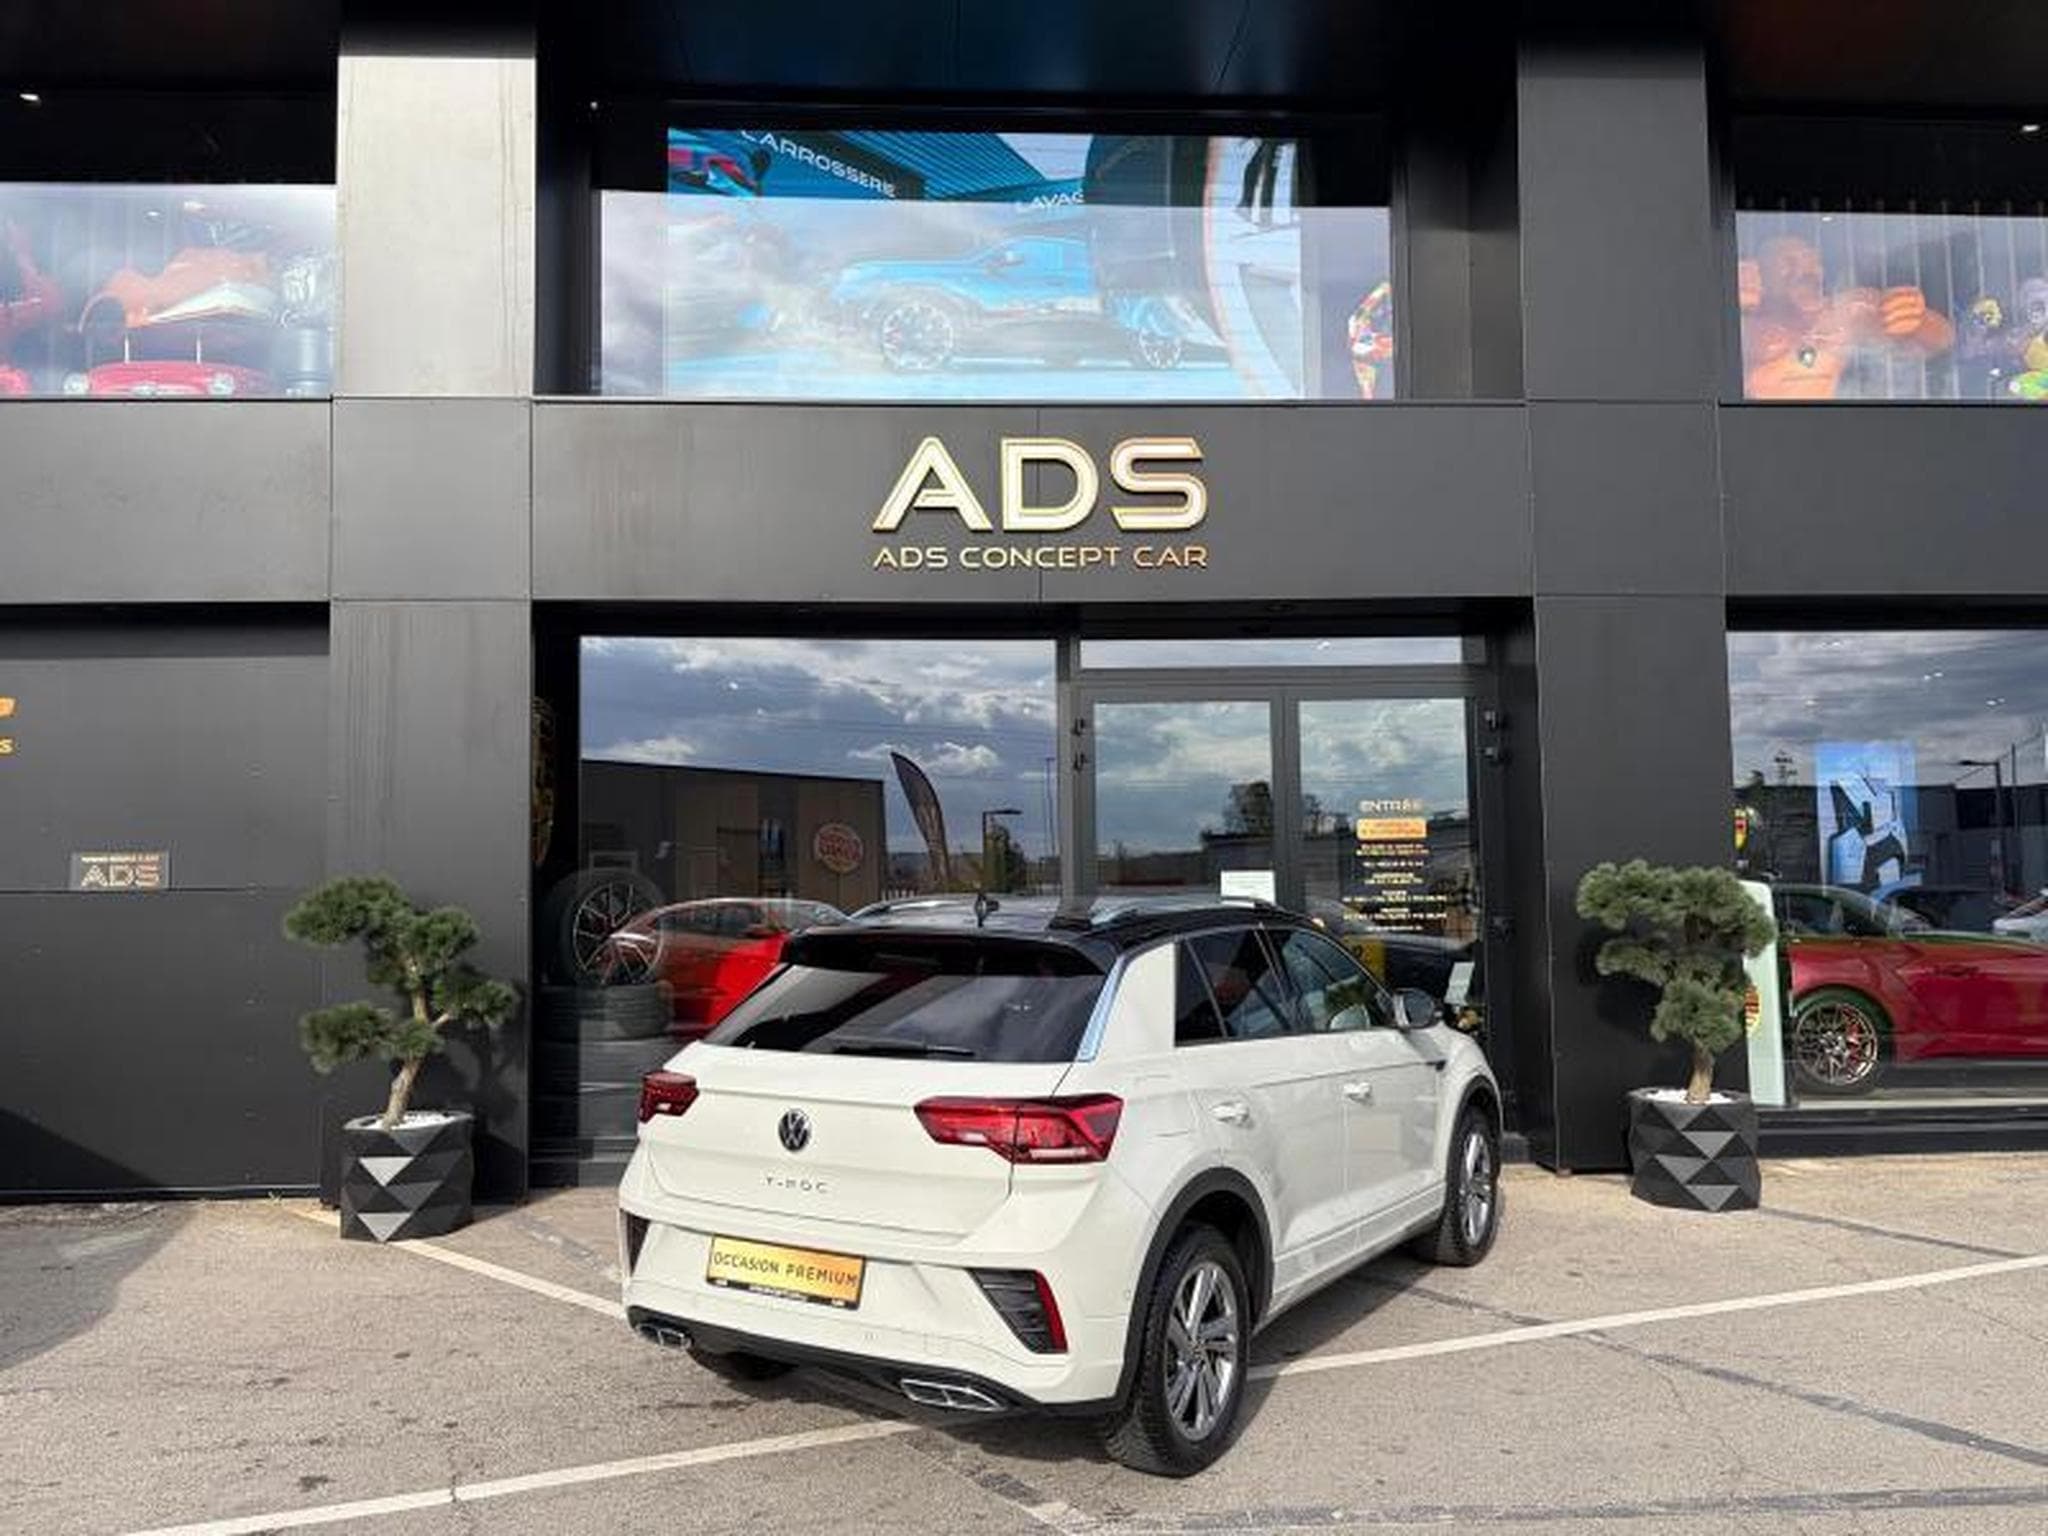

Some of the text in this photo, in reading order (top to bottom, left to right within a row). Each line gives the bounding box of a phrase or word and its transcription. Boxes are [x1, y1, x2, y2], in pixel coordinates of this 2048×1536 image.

[872, 436, 1207, 533] ADS
[872, 547, 1208, 568] ADS CONCEPT CAR
[80, 864, 160, 887] ADS
[713, 1251, 858, 1288] OCCASION PREMIUM
